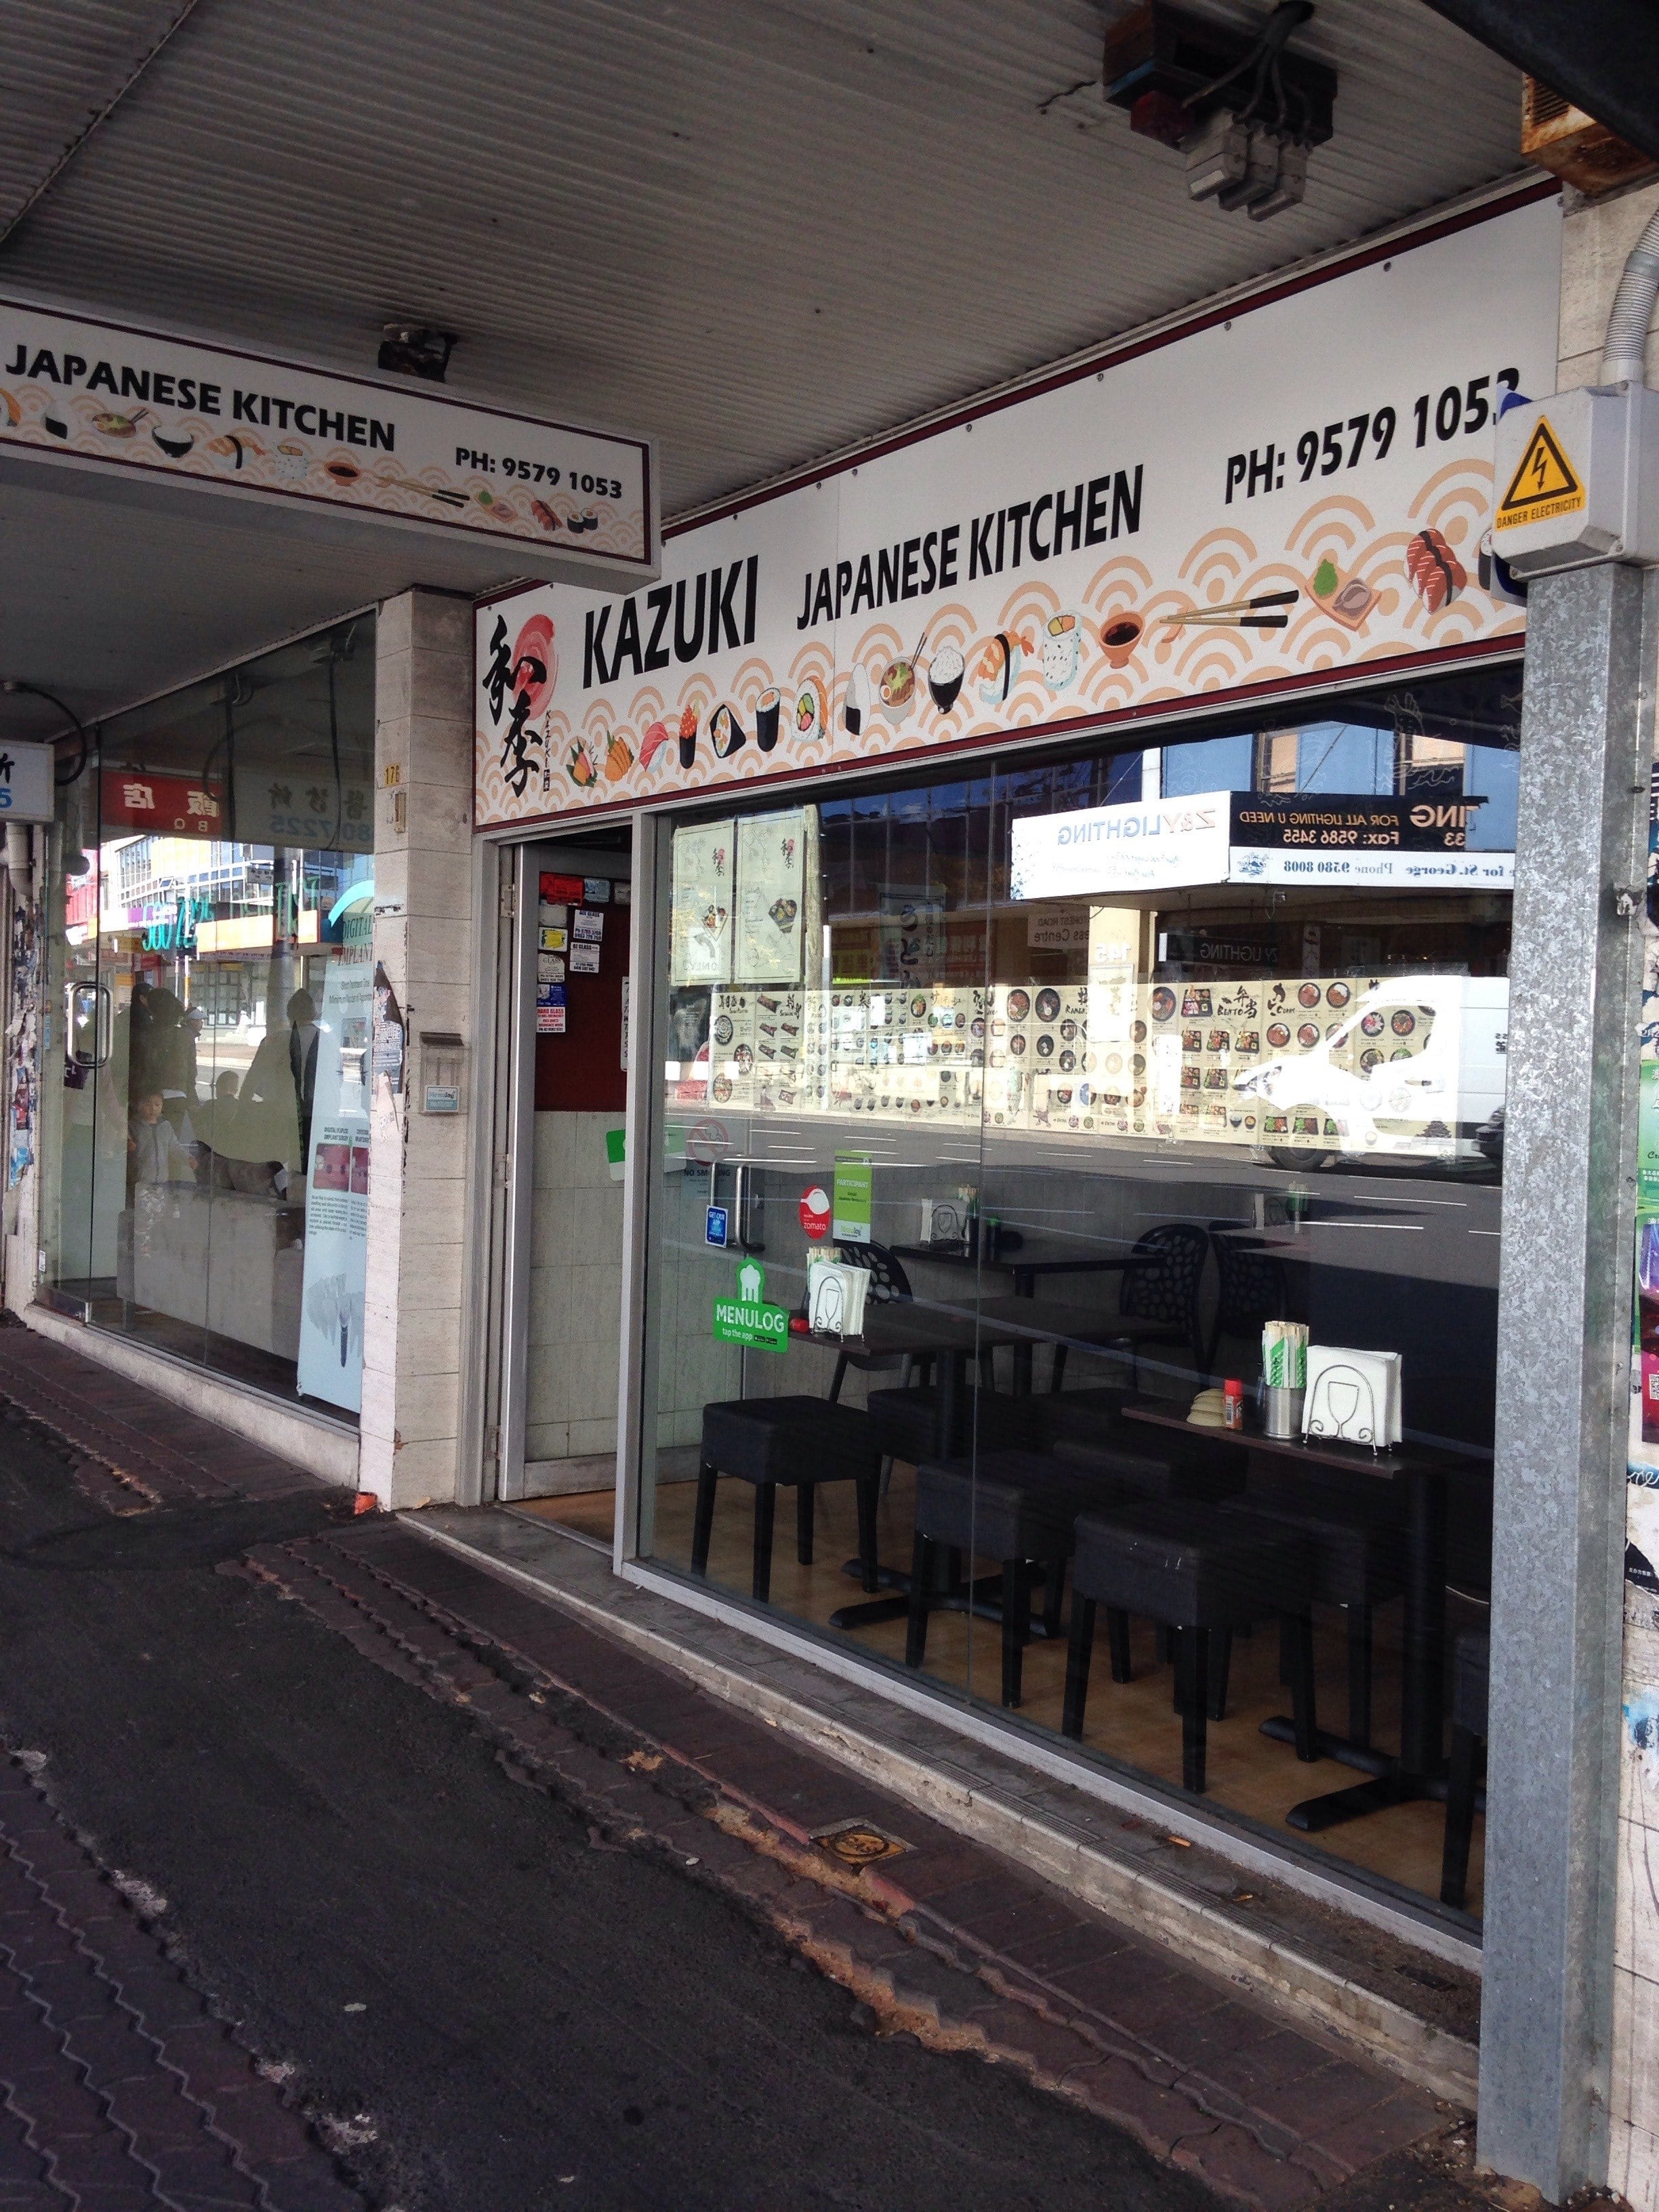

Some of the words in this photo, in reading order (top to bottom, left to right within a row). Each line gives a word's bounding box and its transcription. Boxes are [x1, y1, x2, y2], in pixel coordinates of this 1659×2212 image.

[5, 344, 223, 415] JAPANESE
[232, 389, 395, 451] KITCHEN
[455, 447, 495, 473] PH:
[501, 457, 560, 486] 9579
[568, 472, 623, 499] 1053
[1224, 443, 1285, 504] PH:
[1296, 406, 1396, 483] 9579
[1496, 511, 1528, 529] DANGER
[1532, 497, 1581, 520] ELECTRICITY
[797, 525, 960, 630] JAPANESE
[968, 464, 1143, 581] KITCHEN
[583, 555, 758, 689] KAZUKI
[342, 915, 372, 939] DIGITAL
[803, 1222, 826, 1231] zomato
[716, 1304, 785, 1333] MENULOG
[722, 1327, 732, 1337] tap
[732, 1328, 741, 1337] the
[741, 1332, 753, 1341] app
